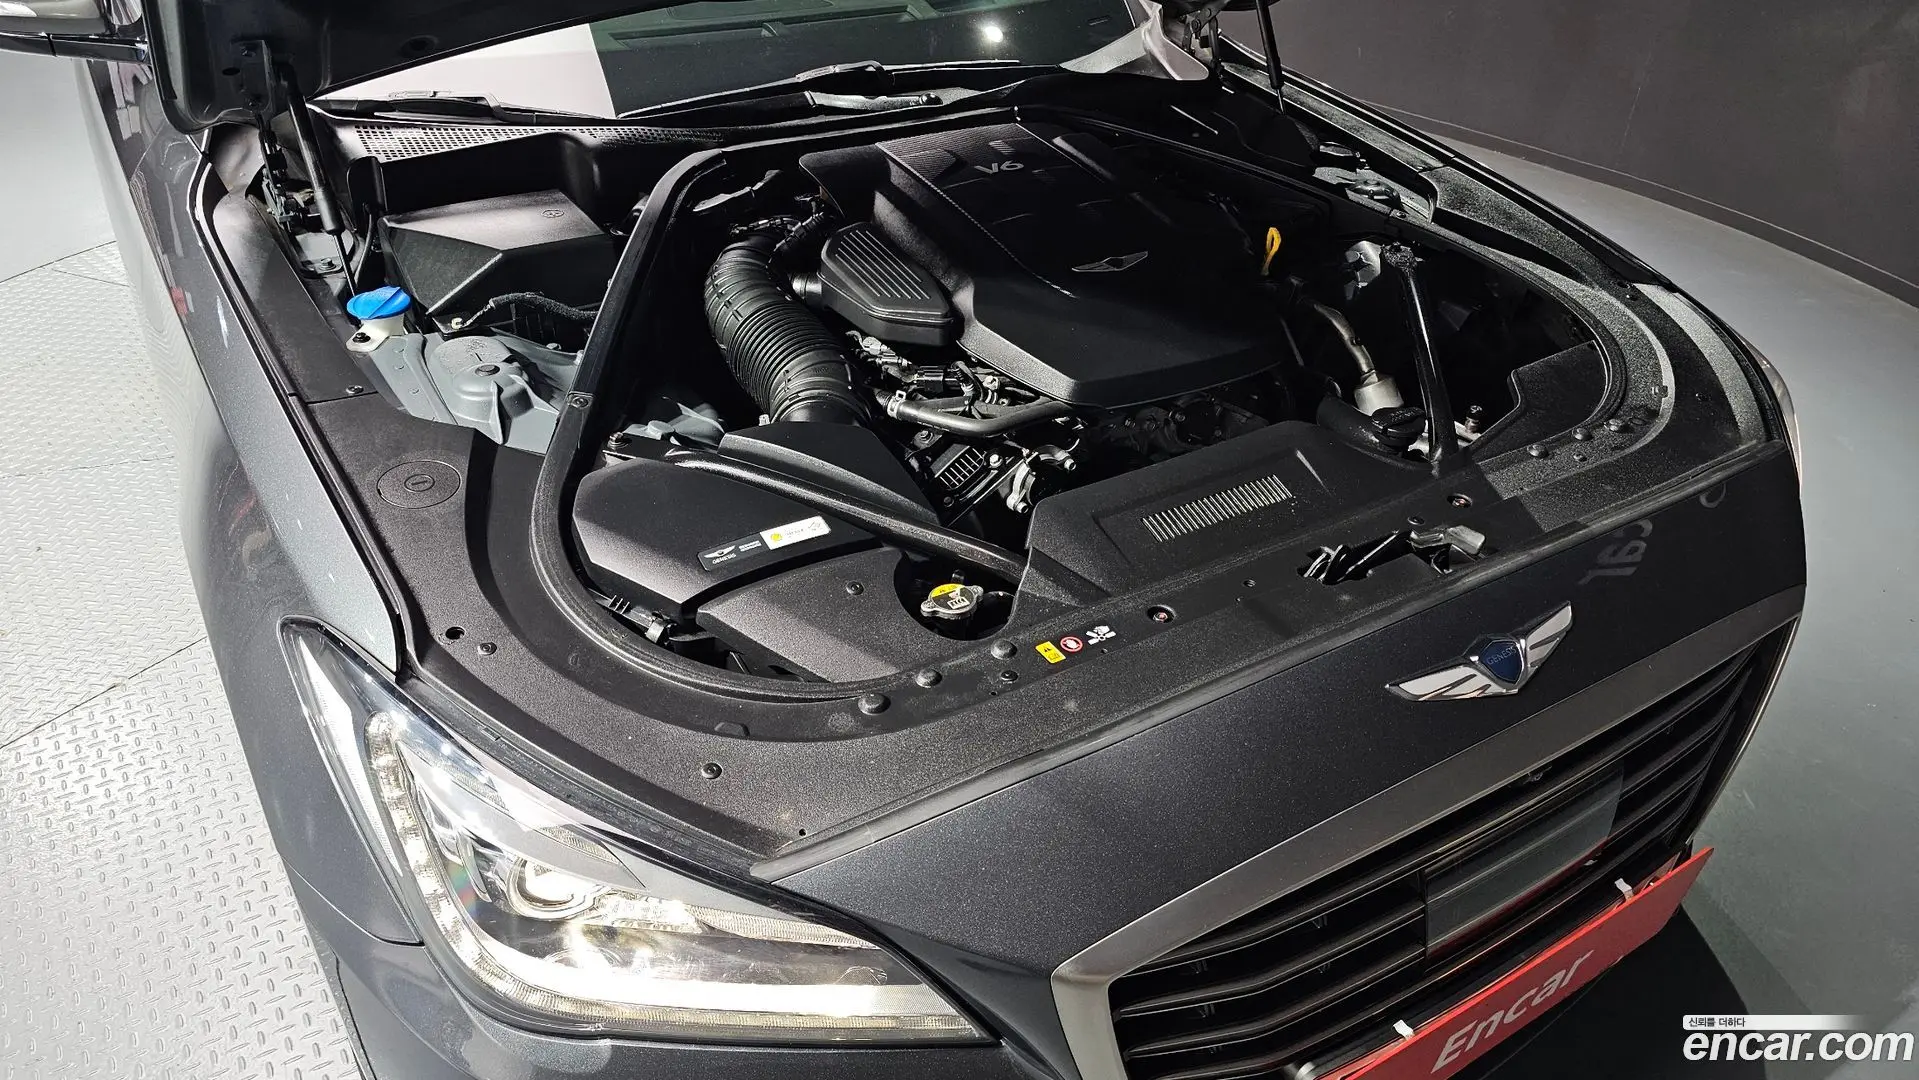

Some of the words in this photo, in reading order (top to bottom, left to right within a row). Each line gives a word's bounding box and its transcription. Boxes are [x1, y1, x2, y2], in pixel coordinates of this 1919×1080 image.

[974, 160, 1025, 175] V6
[1486, 646, 1518, 666] GENESIS
[1430, 949, 1595, 1074] Encar
